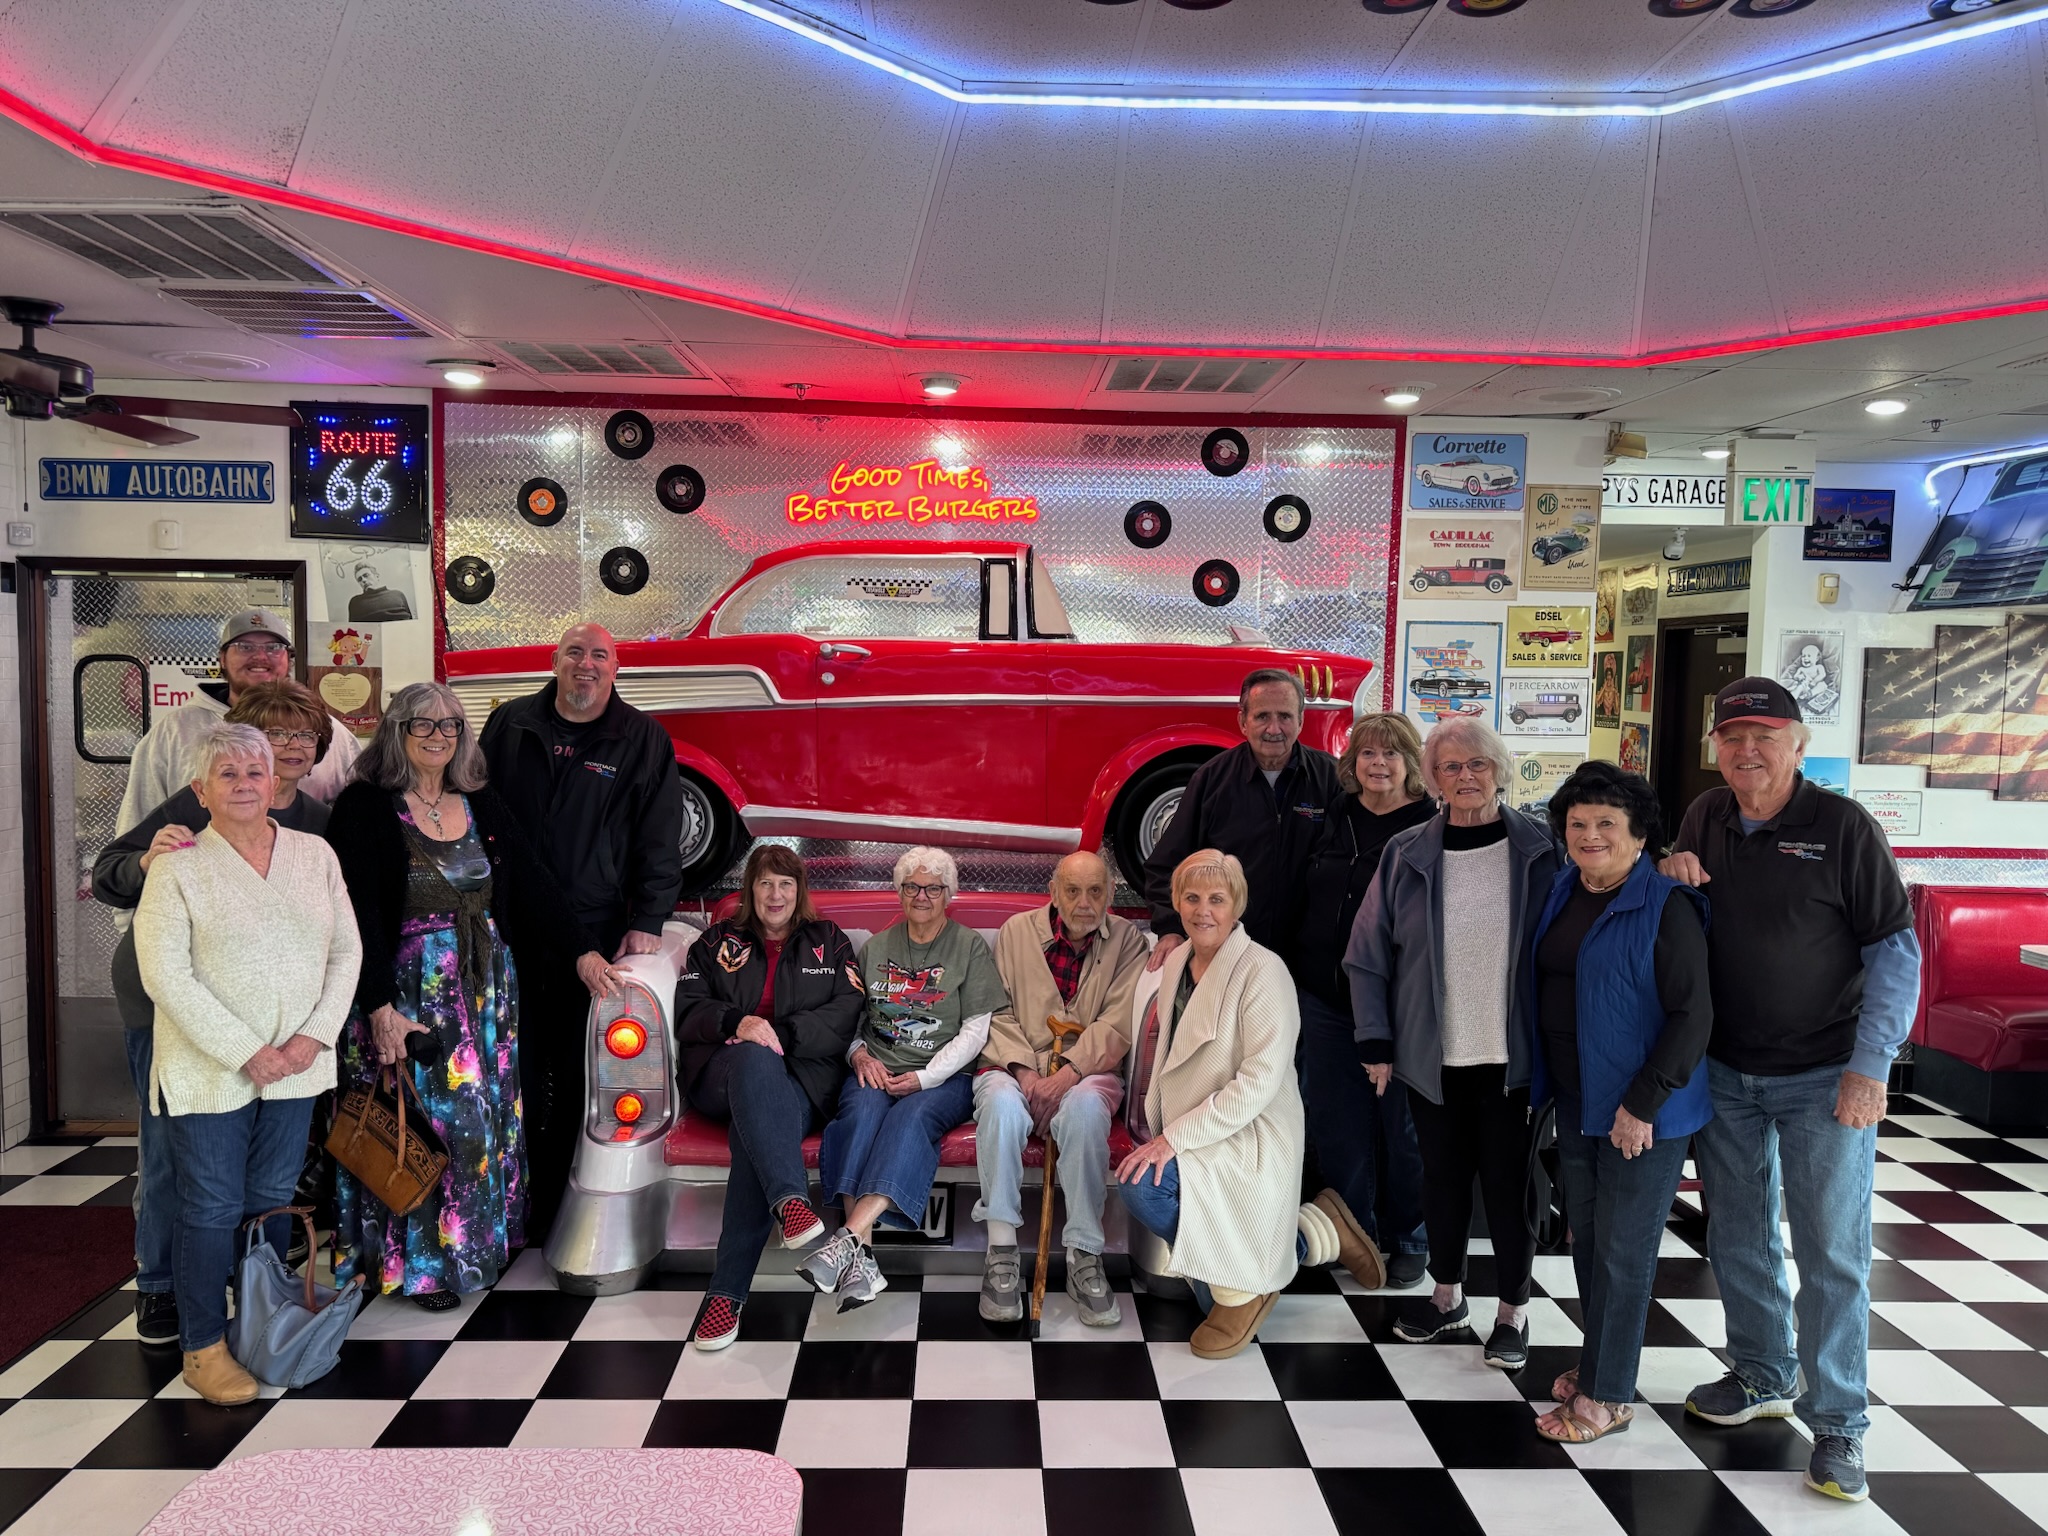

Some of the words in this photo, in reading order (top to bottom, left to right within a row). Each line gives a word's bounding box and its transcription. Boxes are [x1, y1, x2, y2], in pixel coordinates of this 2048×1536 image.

[321, 430, 396, 455] ROUTE
[1433, 435, 1507, 454] Corvette
[55, 463, 110, 495] BMW
[126, 465, 261, 498] AUTOBAHN
[325, 458, 392, 512] 66
[830, 460, 902, 495] GOOD
[908, 460, 989, 493] TIMES,
[1648, 478, 1726, 504] GARAGE
[1743, 477, 1810, 522] EXIT
[788, 494, 903, 522] BETTER
[908, 495, 1037, 522] BURGERS
[1428, 497, 1458, 508] SALES
[1465, 498, 1506, 509] SERVICE
[1539, 495, 1557, 513] MG
[1429, 530, 1495, 541] CADILLAC
[1694, 563, 1728, 590] GORDON
[1535, 611, 1562, 621] EDSEL
[1415, 649, 1468, 660] MONTE
[1512, 653, 1536, 661] SALES
[1540, 653, 1546, 661] &
[1550, 653, 1583, 661] SERVICE
[1432, 659, 1483, 670] CARLO
[1509, 681, 1580, 690] PIERCE-ARROW
[153, 683, 194, 706] Em
[1420, 697, 1451, 712] SS
[1523, 762, 1540, 779] MG
[1872, 810, 1902, 819] STARR
[869, 981, 888, 992] ALL
[910, 1039, 935, 1049] 2025
